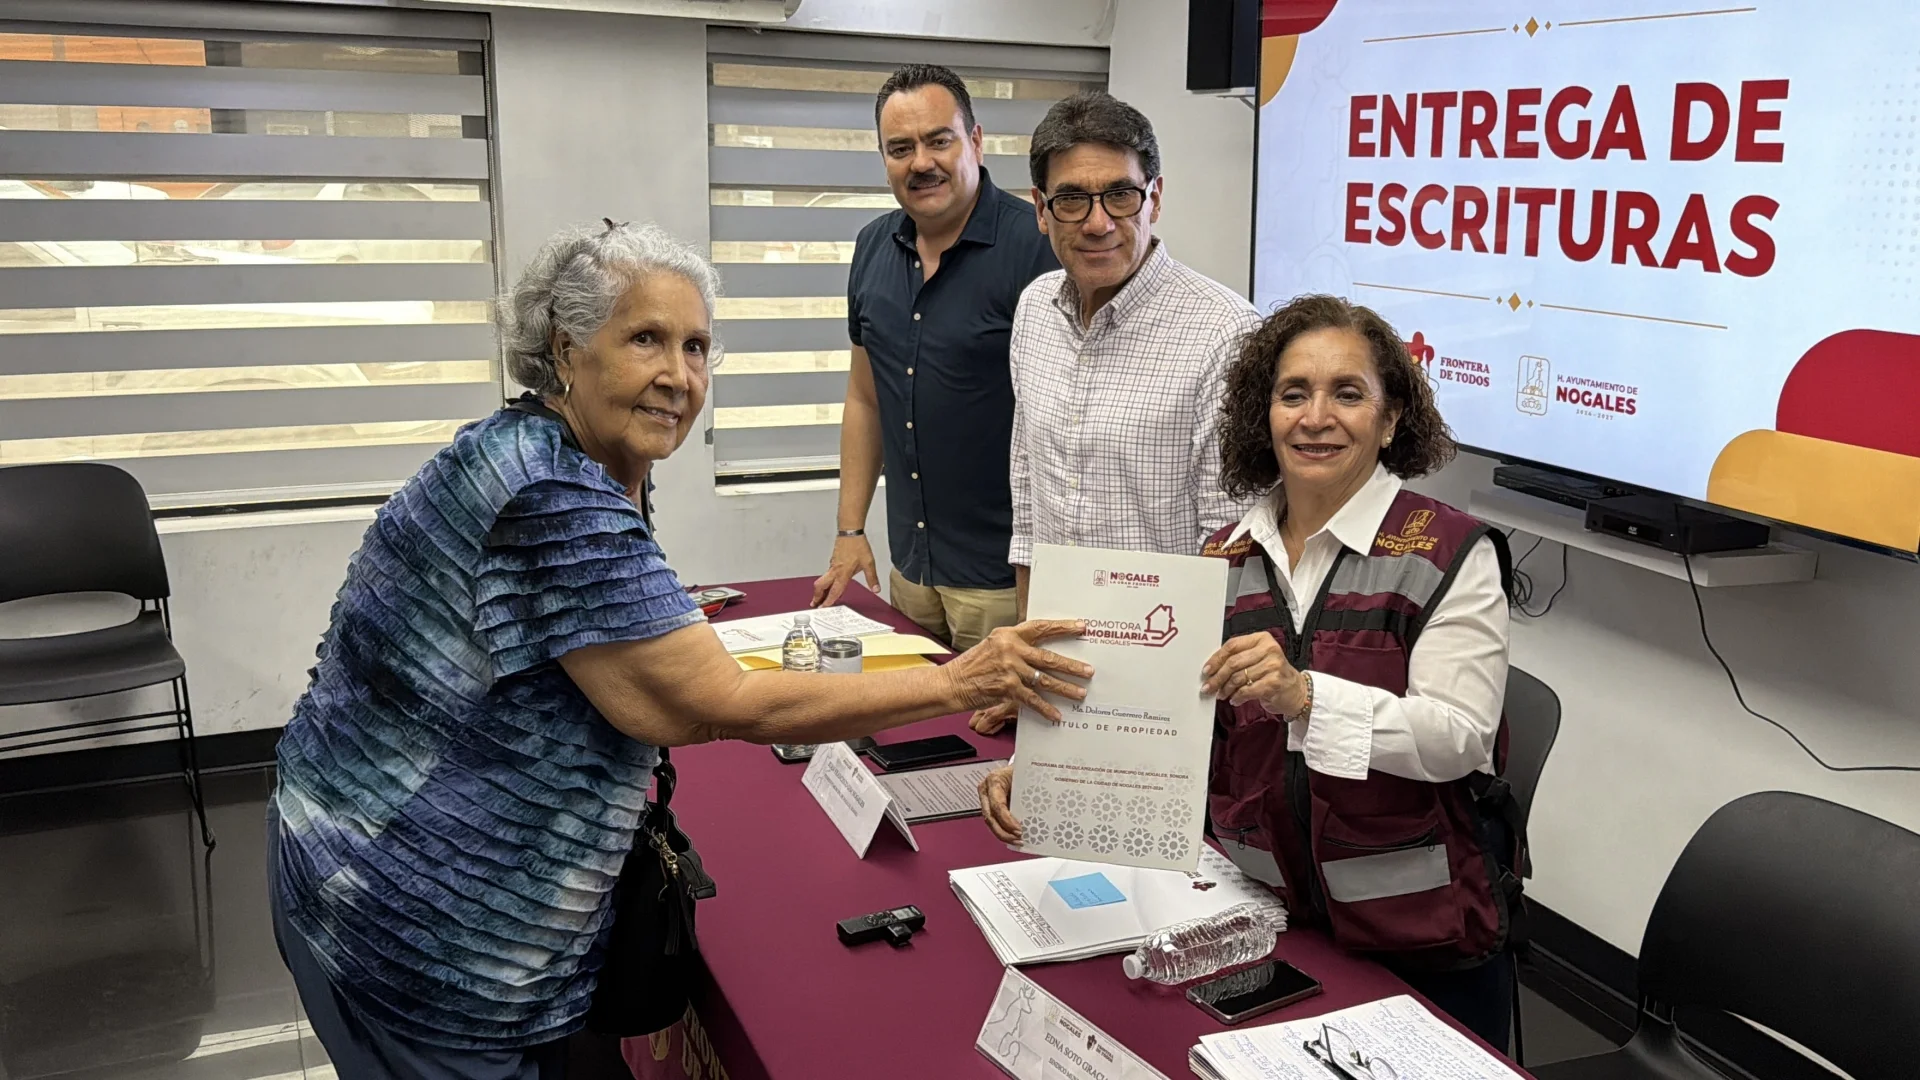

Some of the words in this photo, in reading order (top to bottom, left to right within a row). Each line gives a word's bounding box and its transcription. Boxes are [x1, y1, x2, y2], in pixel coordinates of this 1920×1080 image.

[1348, 85, 1646, 161] ENTREGA
[1670, 79, 1789, 163] DE
[1344, 182, 1780, 277] ESCRITURAS
[1440, 357, 1490, 374] FRONTERA
[1439, 369, 1453, 380] DE
[1455, 372, 1490, 387] TODOS
[1557, 374, 1565, 383] H.
[1566, 375, 1626, 393] AYUNTAMIENTO
[1627, 386, 1638, 395] DE
[1556, 386, 1637, 415] NOGALES
[1375, 537, 1434, 551] NOGALES
[1110, 571, 1160, 583] NOGALES
[1085, 706, 1111, 716] Dolores
[1112, 709, 1143, 719] Guerrero
[1096, 723, 1109, 731] DE
[1117, 725, 1178, 736] PROPIEDAD
[1059, 1018, 1081, 1038] NOGALES
[1045, 1032, 1064, 1053] EDNA
[1063, 1046, 1083, 1066] SOTO
